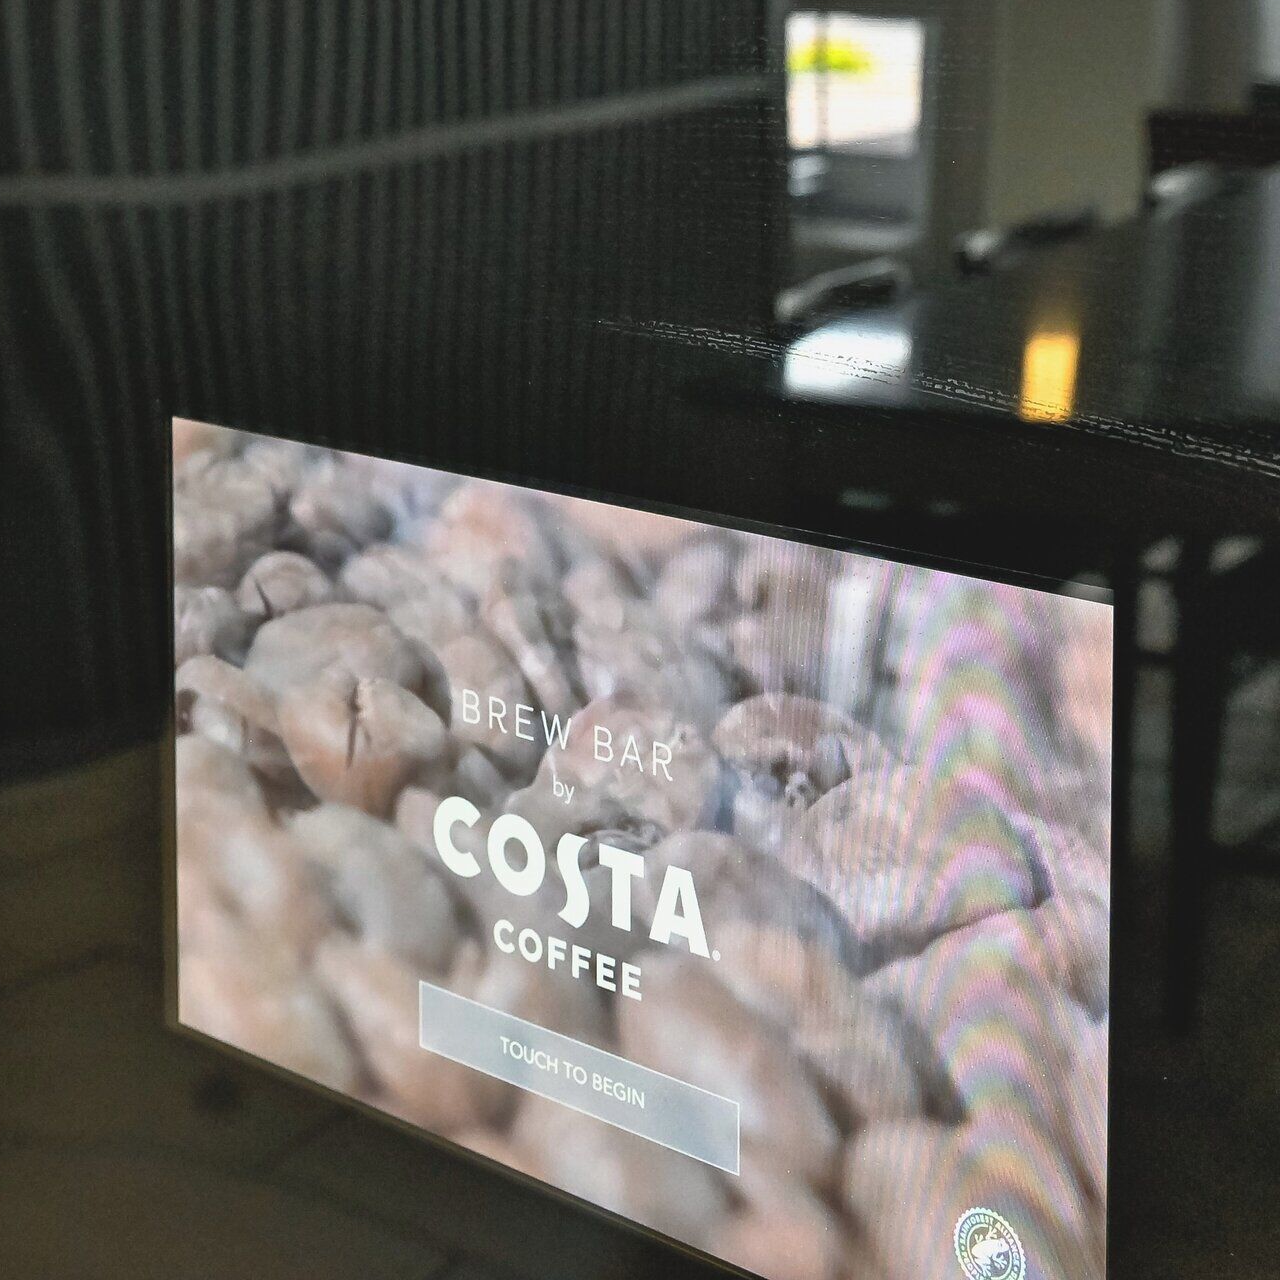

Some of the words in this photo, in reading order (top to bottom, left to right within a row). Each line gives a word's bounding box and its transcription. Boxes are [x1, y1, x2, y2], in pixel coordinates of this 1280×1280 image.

[460, 688, 573, 751] BREW
[593, 725, 675, 783] BAR
[551, 773, 576, 805] by
[433, 795, 713, 959] COSTA
[493, 919, 643, 1002] COFFEE
[498, 1035, 559, 1076] TOUCH
[562, 1060, 588, 1086] TO
[591, 1071, 646, 1110] BEGIN
